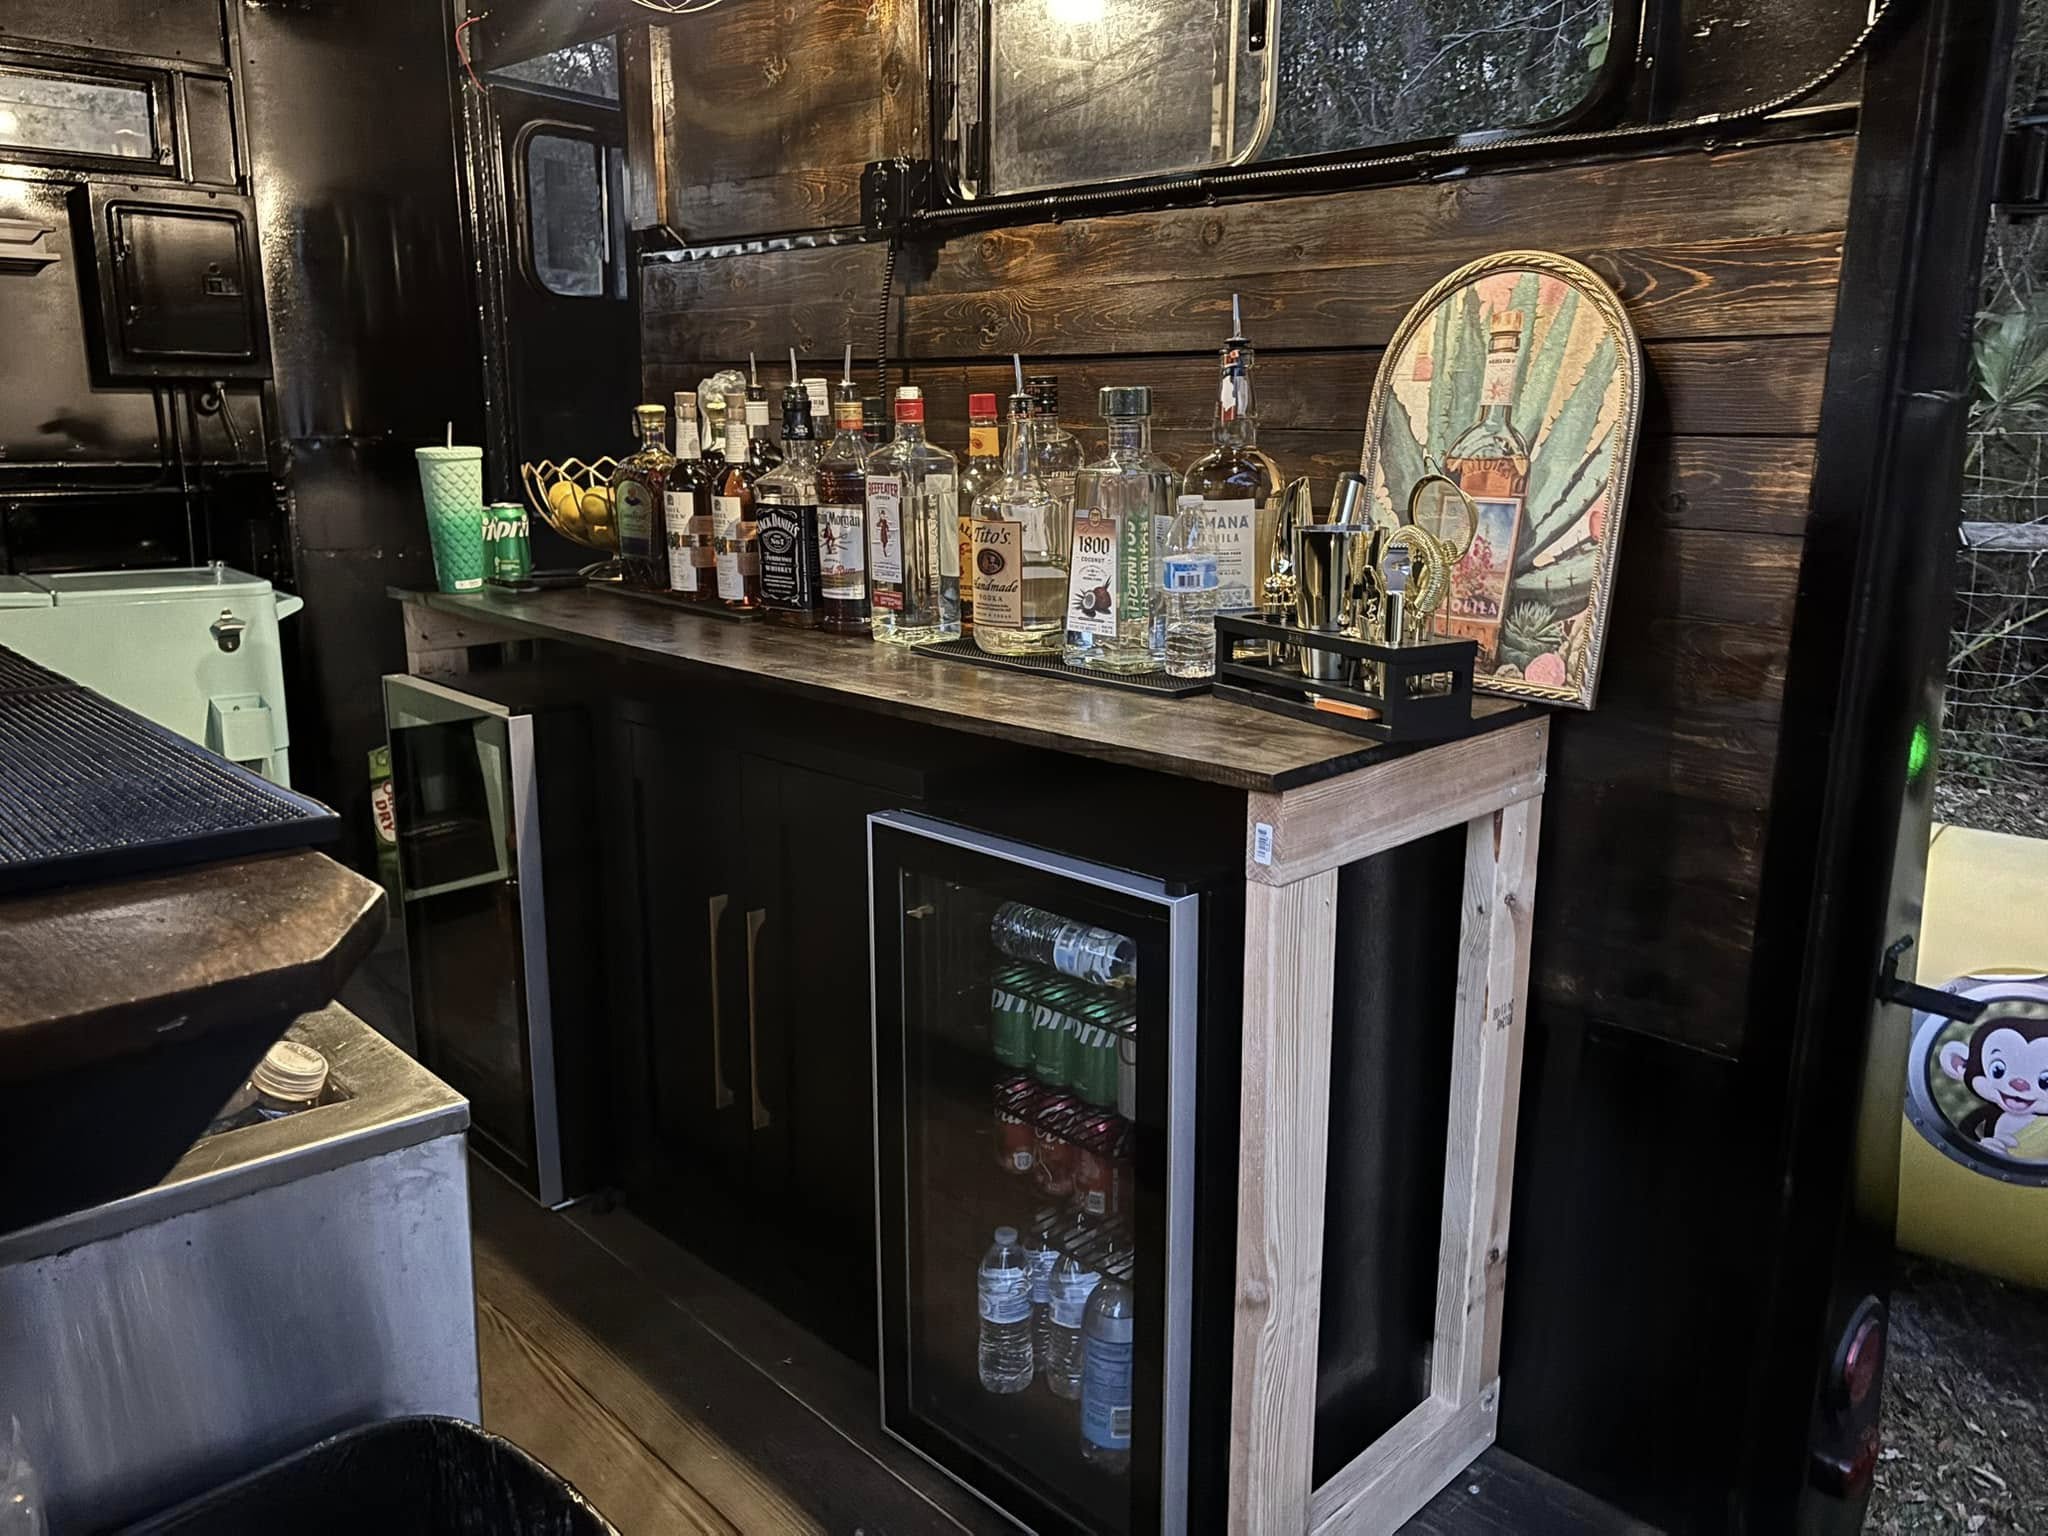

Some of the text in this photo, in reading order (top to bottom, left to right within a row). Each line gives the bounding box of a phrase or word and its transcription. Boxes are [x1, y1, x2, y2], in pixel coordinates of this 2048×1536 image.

[868, 482, 898, 497] BEEFEATER
[756, 517, 771, 533] JACK
[830, 512, 861, 528] Morgan
[1079, 536, 1110, 554] 1800
[765, 565, 793, 574] WHISKEY
[375, 800, 395, 832] DRY
